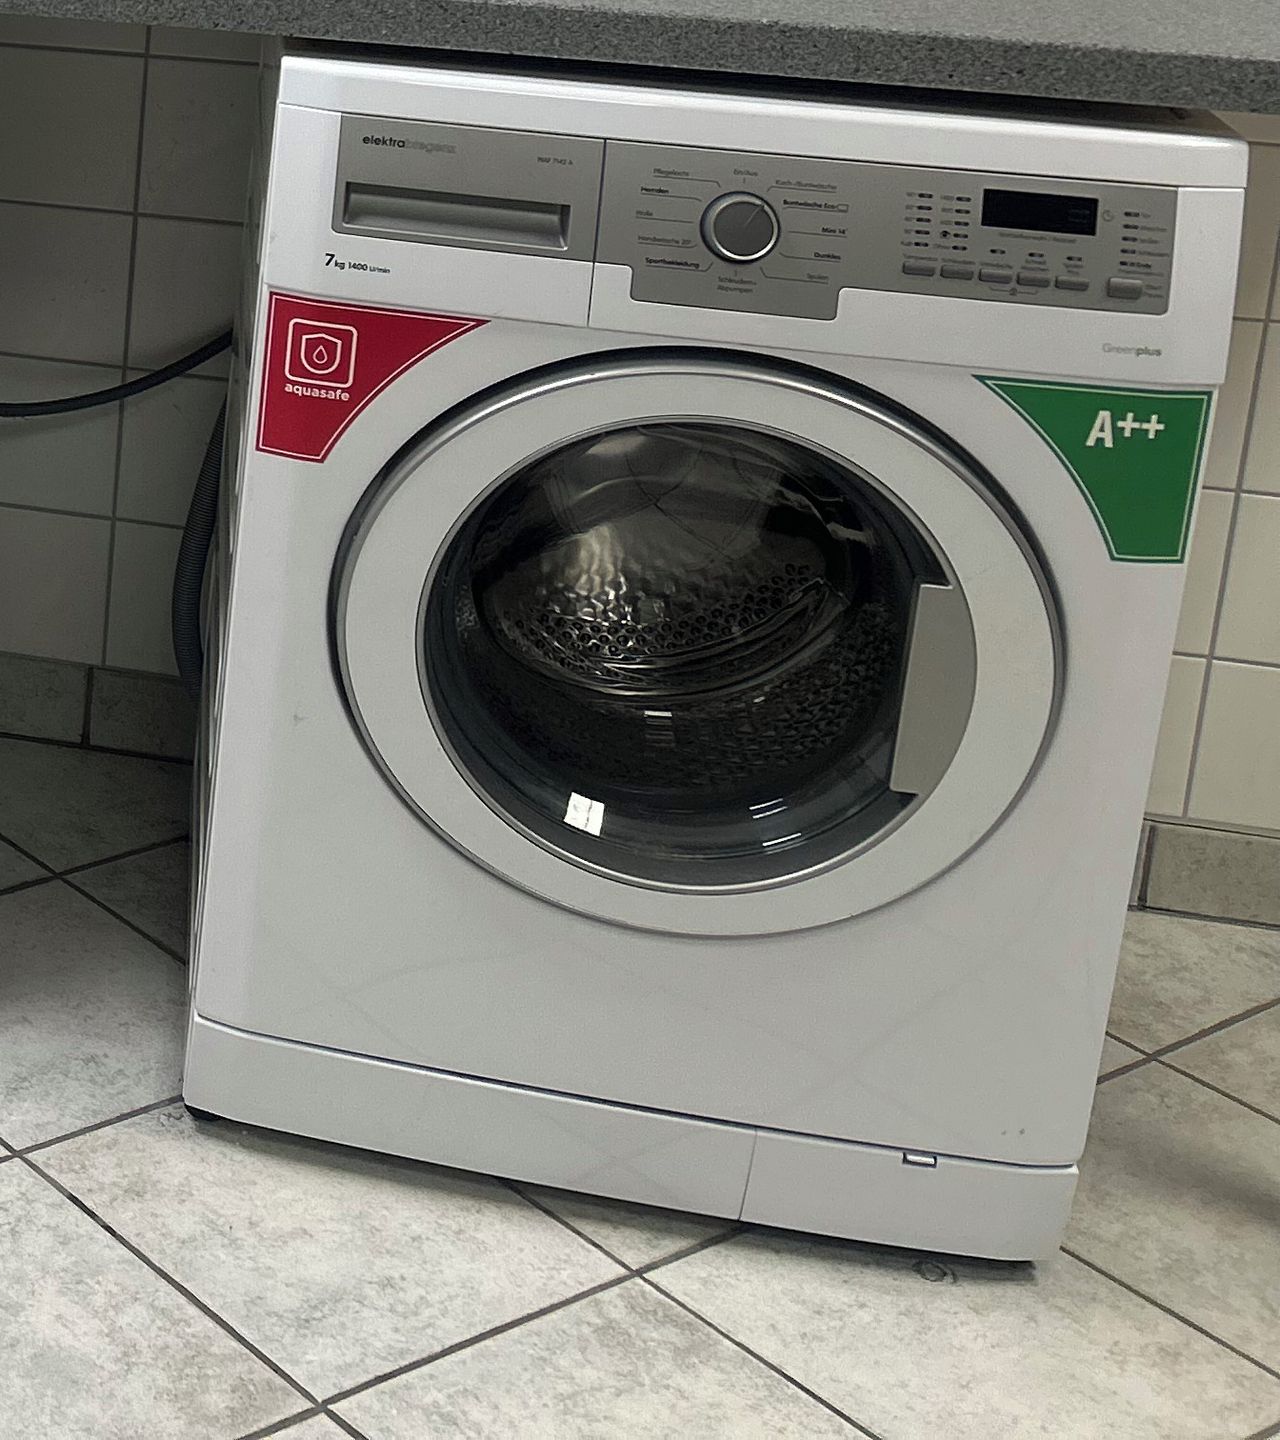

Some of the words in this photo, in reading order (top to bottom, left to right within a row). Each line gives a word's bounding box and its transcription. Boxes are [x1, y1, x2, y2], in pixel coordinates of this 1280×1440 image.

[362, 134, 457, 154] elektrabregenz
[348, 261, 368, 272] 1400
[1102, 342, 1162, 357] Greenplus
[284, 382, 350, 401] aquasafe
[1085, 409, 1166, 448] A++
